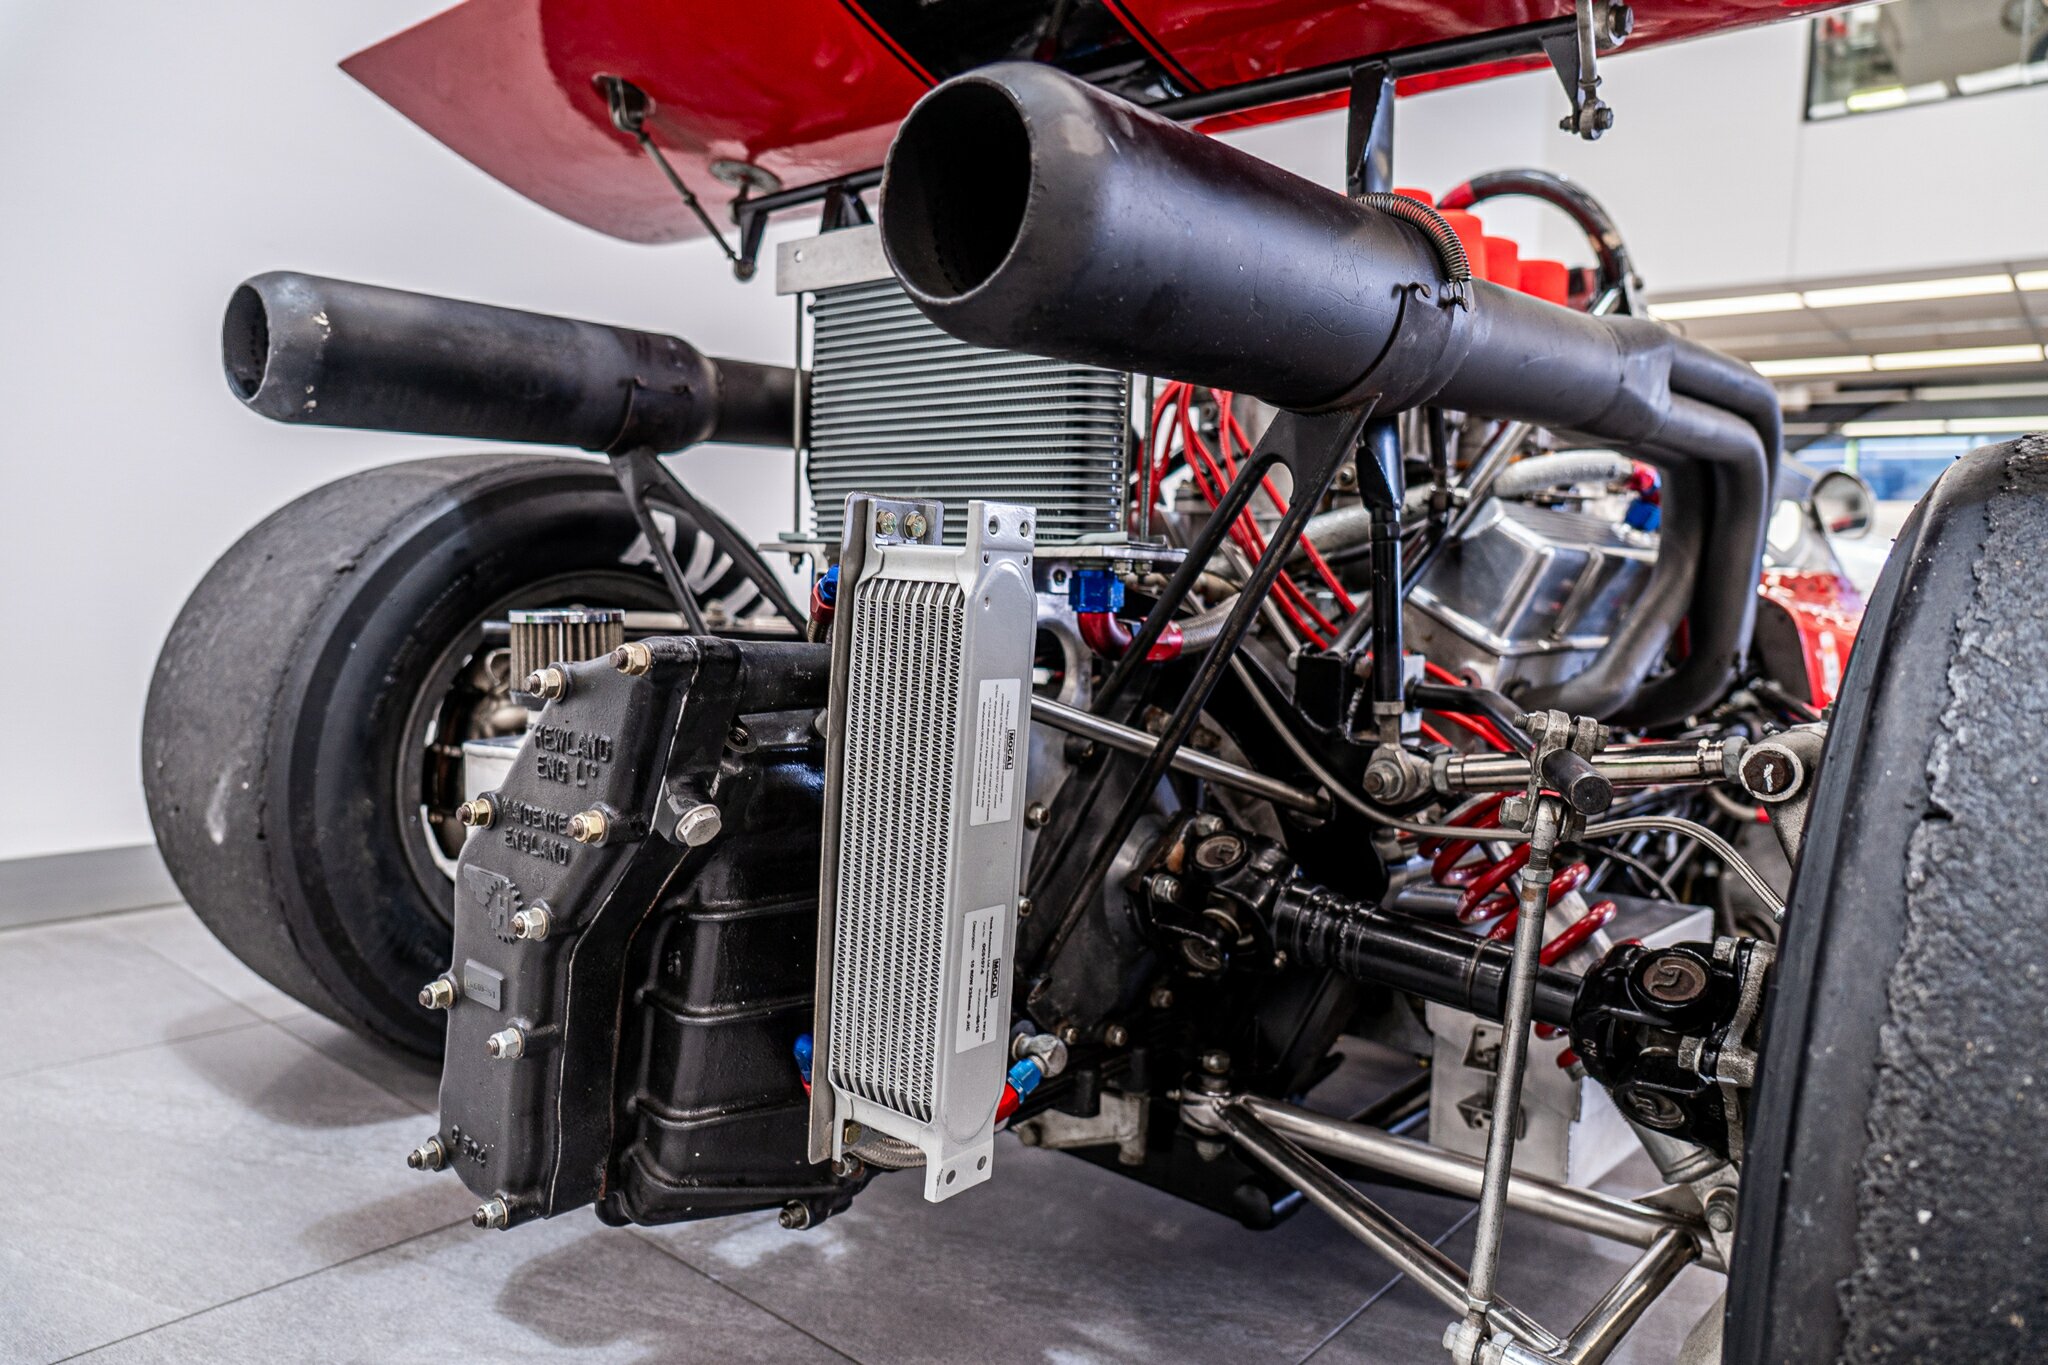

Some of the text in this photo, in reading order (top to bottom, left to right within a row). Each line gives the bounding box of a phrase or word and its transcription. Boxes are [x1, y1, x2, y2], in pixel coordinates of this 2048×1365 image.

[537, 752, 568, 784] ENG
[1006, 731, 1014, 768] MOCAL
[504, 826, 571, 866] ENGLAND
[991, 959, 999, 997] MOCAL
